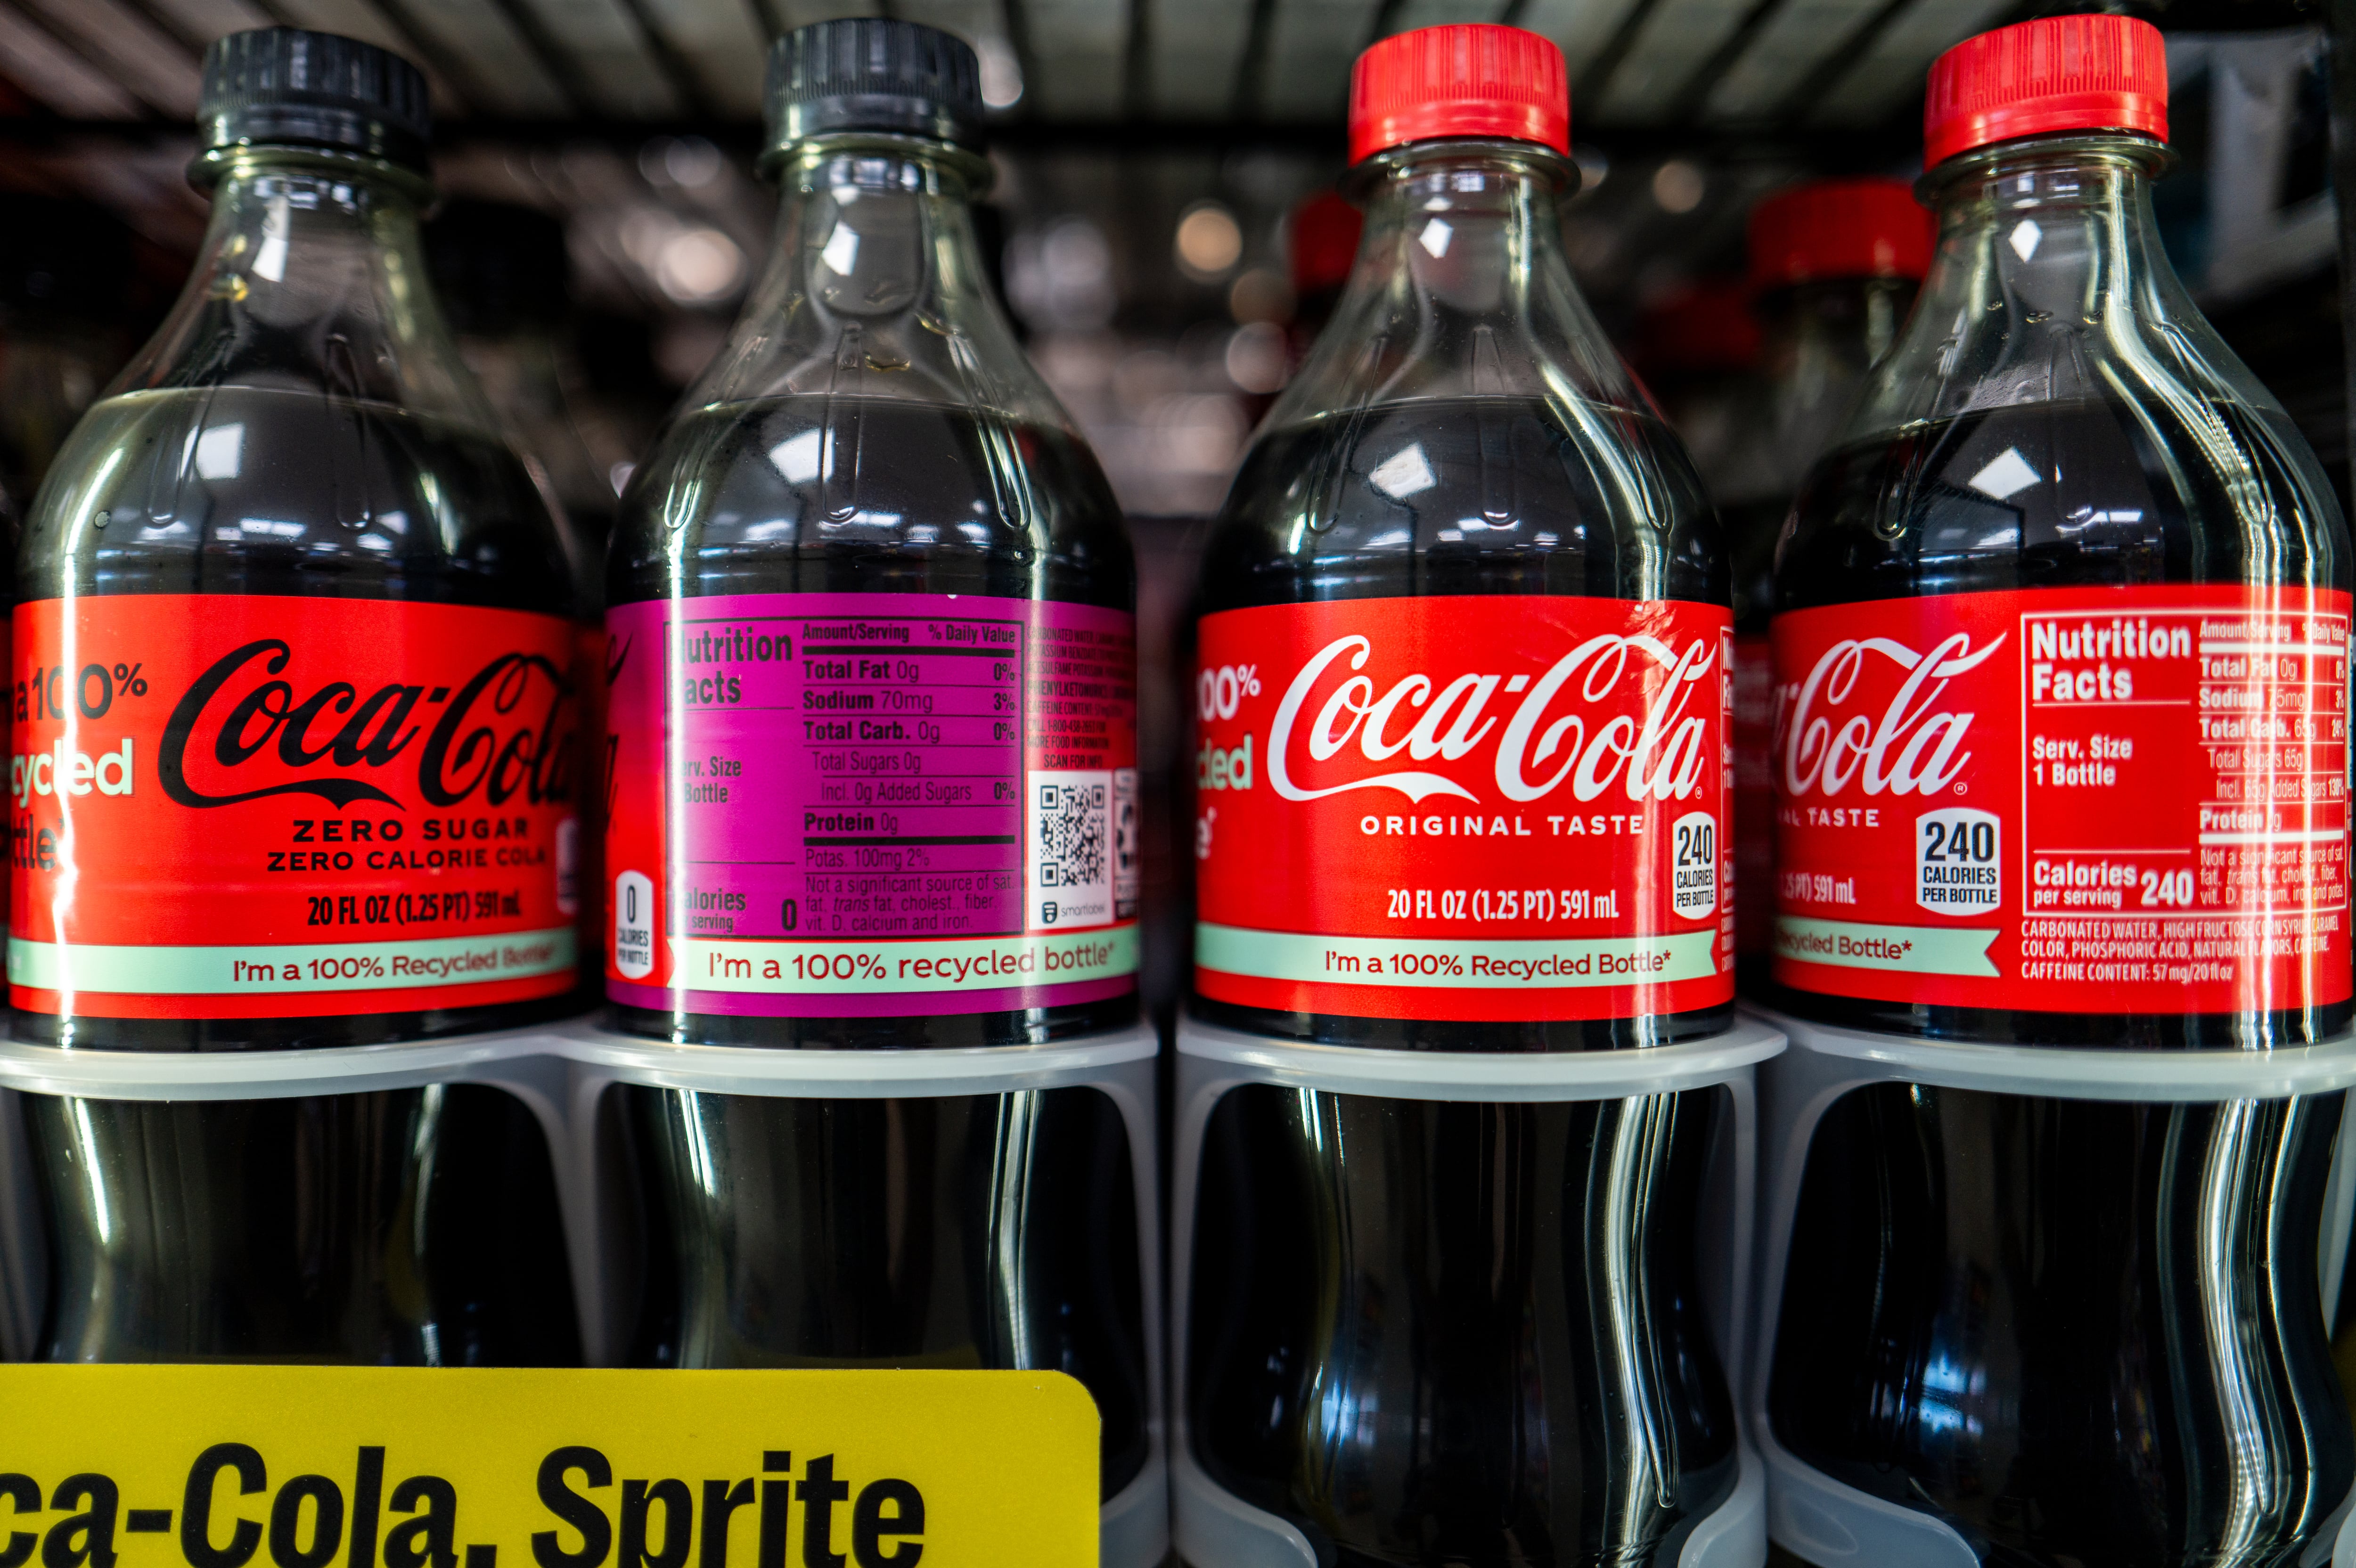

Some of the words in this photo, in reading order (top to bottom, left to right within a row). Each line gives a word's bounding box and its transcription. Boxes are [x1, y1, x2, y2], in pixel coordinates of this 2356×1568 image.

[679, 626, 793, 664] utrition
[802, 622, 909, 643] Amount/Serving
[946, 624, 978, 645] Daily
[982, 626, 1015, 644] Value
[2032, 618, 2191, 659] Nutrition
[2312, 624, 2331, 644] Daily
[2331, 624, 2345, 642] Value
[803, 660, 851, 679] Total
[859, 660, 890, 679] Fat
[897, 660, 919, 683] 0g
[994, 662, 1015, 682] 0%
[2032, 661, 2133, 701] Facts
[2199, 658, 2246, 677] Total
[2251, 658, 2276, 677] Fat
[2280, 658, 2298, 681] 0g
[681, 670, 741, 705] acts
[2199, 687, 2264, 708] Sodium
[2268, 689, 2305, 711] 75mg
[802, 690, 874, 710] Sodium
[881, 690, 933, 714] 70mg
[994, 693, 1015, 711] 3%
[1267, 634, 1717, 804] Coca-Cola
[2199, 718, 2246, 738] Total
[803, 721, 852, 740] Total
[859, 720, 911, 740] Carb.
[918, 721, 940, 743] 0g
[994, 721, 1015, 741] 0%
[2032, 735, 2085, 760] Serv.
[2090, 734, 2133, 760] Size
[710, 756, 742, 777] Size
[812, 751, 846, 771] Total
[850, 751, 900, 774] Sugars
[904, 753, 921, 774] 0g
[1044, 754, 1068, 768] SCAN
[1070, 754, 1085, 768] FOR
[2207, 749, 2238, 768] Total
[2243, 749, 2282, 772] Sugars
[2285, 749, 2303, 771] 65g
[2033, 763, 2044, 786] 1
[2052, 762, 2116, 786] Bottle
[684, 782, 728, 803] Bottle
[855, 783, 872, 805] 0g
[877, 782, 920, 801] Added
[925, 782, 972, 804] Sugars
[994, 781, 1015, 800] 0%
[2245, 779, 2265, 801] 65g
[2269, 779, 2298, 799] Added
[804, 813, 874, 832] Protein
[881, 812, 899, 835] 0g
[1360, 815, 1531, 836] ORIGINAL
[1547, 815, 1644, 836] TASTE
[1807, 807, 1880, 827] TASTE
[2200, 810, 2264, 830] Protein
[293, 819, 403, 842] ZERO
[423, 818, 528, 841] SUGAR
[1677, 825, 1713, 866] 240
[1925, 822, 1995, 862] 240
[267, 851, 353, 872] ZERO
[367, 849, 487, 871] CALORIE
[496, 848, 547, 866] COLA
[806, 848, 848, 867] Potas.
[853, 849, 902, 871] 100mg
[906, 848, 930, 867] 2%
[2201, 849, 2225, 866] Not
[2228, 852, 2236, 866] a
[2240, 848, 2298, 868] signicant
[805, 876, 830, 894] Not
[835, 880, 843, 893] a
[848, 874, 922, 897] significant
[927, 877, 972, 893] source
[977, 874, 990, 891] of
[1676, 868, 1714, 890] CALORIES
[1922, 866, 1997, 885] CALORIES
[2034, 858, 2137, 887] Calories
[2141, 869, 2194, 907] 240
[2227, 869, 2258, 885] trans
[2282, 865, 2320, 883] cholet.,
[1676, 891, 1692, 908] PER
[1693, 889, 1714, 907] BOTTLE
[1814, 874, 1834, 903] 591
[1835, 877, 1857, 905] mL
[1922, 887, 1947, 903] PER
[1950, 888, 1997, 905] BOTTLE
[2033, 889, 2060, 908] per
[2063, 887, 2122, 910] serving
[2243, 887, 2290, 904] calcum,
[2313, 883, 2327, 900] and
[308, 896, 333, 926] 20
[339, 895, 360, 924] FL
[366, 895, 390, 924] OZ
[396, 892, 439, 926] (1.25
[443, 890, 471, 923] PT)
[475, 890, 499, 919] 591
[627, 884, 636, 923] 0
[781, 898, 797, 931] 0
[833, 897, 869, 913] trans
[1387, 889, 1410, 918] 20
[1416, 890, 1437, 919] FL
[1441, 890, 1467, 919] OZ
[1472, 889, 1518, 922] (1.25
[1523, 889, 1556, 922] PT)
[1561, 890, 1590, 919] 591
[1594, 890, 1619, 919] mL
[692, 913, 734, 933] serving
[851, 914, 908, 931] calcium
[912, 914, 938, 930] and
[2021, 920, 2111, 939] CARBONATED
[2112, 921, 2162, 941] WATER,
[2163, 922, 2196, 938] HIGH
[2197, 920, 2255, 938] FRUCTOSE
[2255, 920, 2282, 936] CORN
[2311, 915, 2339, 933] CARAMEL
[2021, 940, 2070, 960] COLOR,
[2072, 941, 2156, 958] PHOSPHORIC
[2159, 941, 2192, 960] ACID,
[2194, 941, 2246, 957] NATURAL
[233, 960, 274, 982] I'm
[282, 964, 302, 981] a
[307, 956, 384, 980] 100%
[392, 947, 498, 979] Recycled
[709, 953, 752, 980] I'm
[762, 958, 781, 979] a
[792, 954, 887, 980] 100%
[899, 949, 1035, 983] recycled
[1325, 950, 1361, 973] I'm
[1367, 956, 1383, 974] a
[1390, 954, 1464, 976] 100%
[1472, 954, 1591, 981] Recycled
[2021, 962, 2085, 980] CAFFEINE
[2087, 963, 2150, 981] CONTENT:
[2152, 964, 2168, 981] 57
[531, 1446, 925, 1568] Sprite
